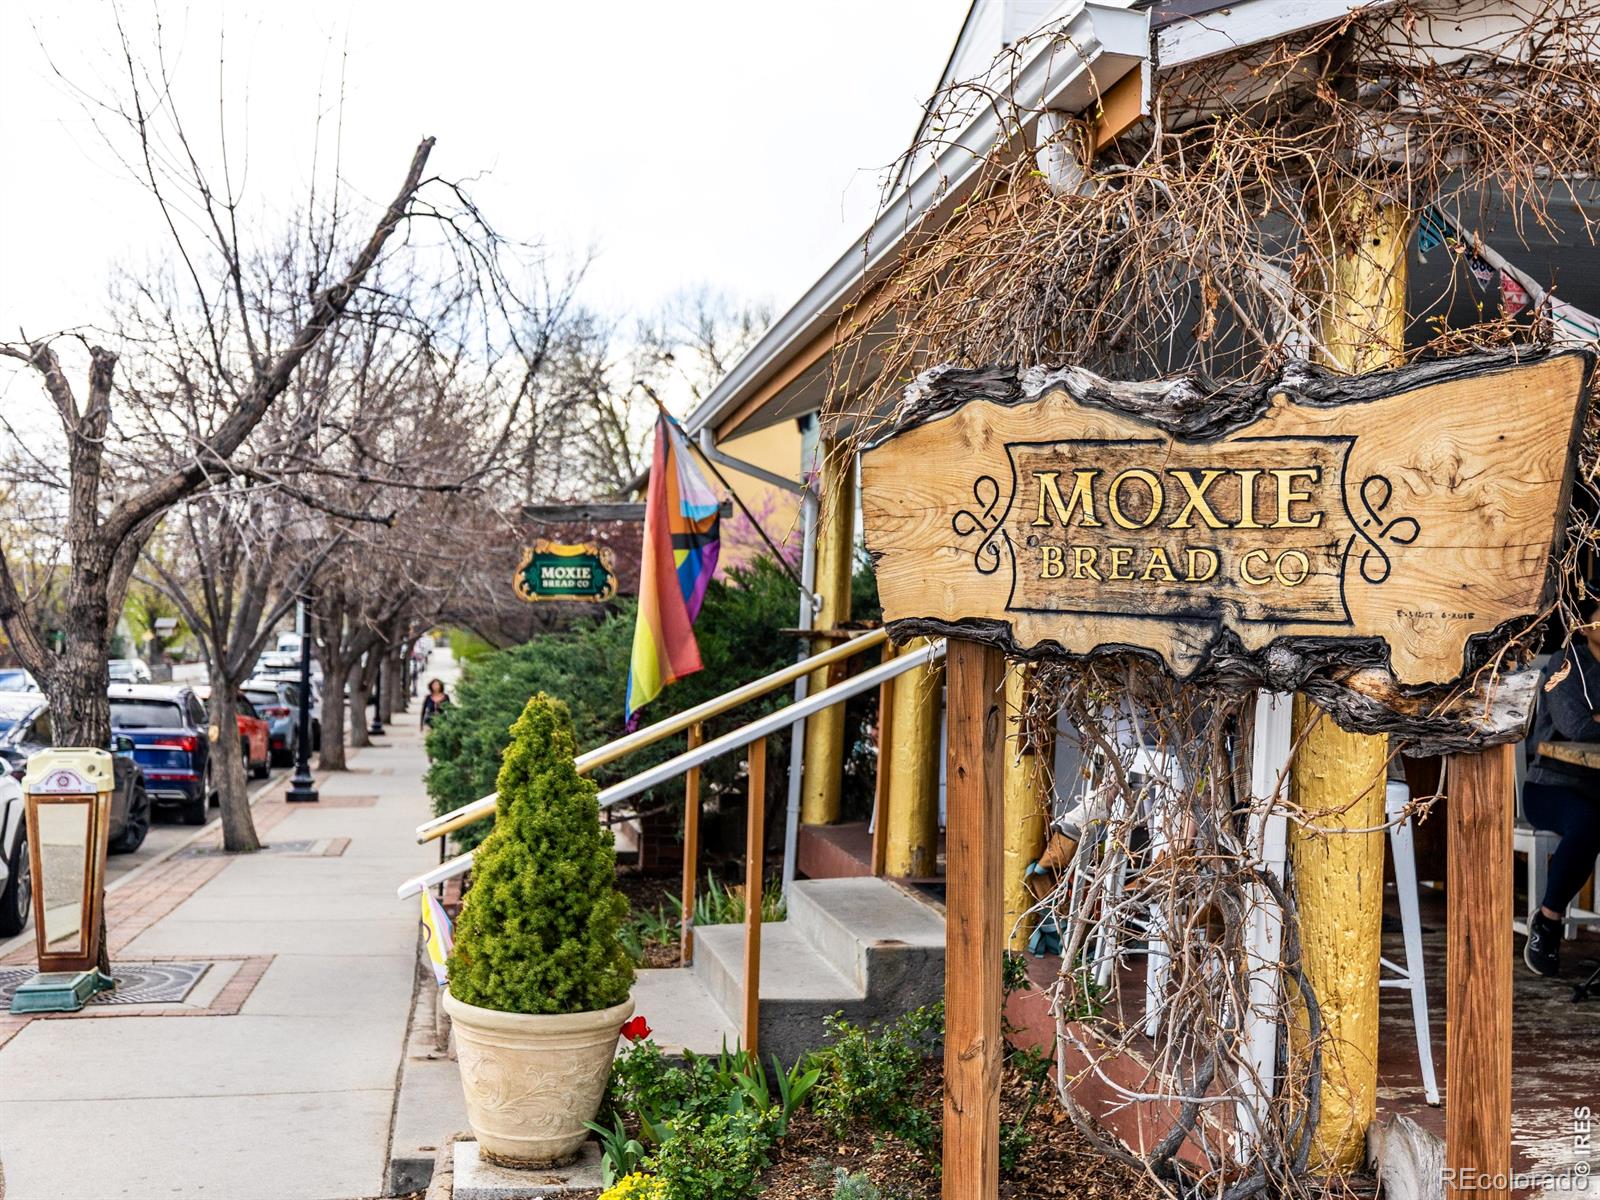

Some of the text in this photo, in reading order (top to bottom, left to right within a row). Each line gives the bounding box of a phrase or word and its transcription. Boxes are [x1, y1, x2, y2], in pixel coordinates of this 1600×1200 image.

[1031, 468, 1324, 530] MOXIE
[541, 567, 591, 579] MOXIE
[1039, 546, 1310, 586] BREAD CO
[542, 580, 590, 588] BREAD CO
